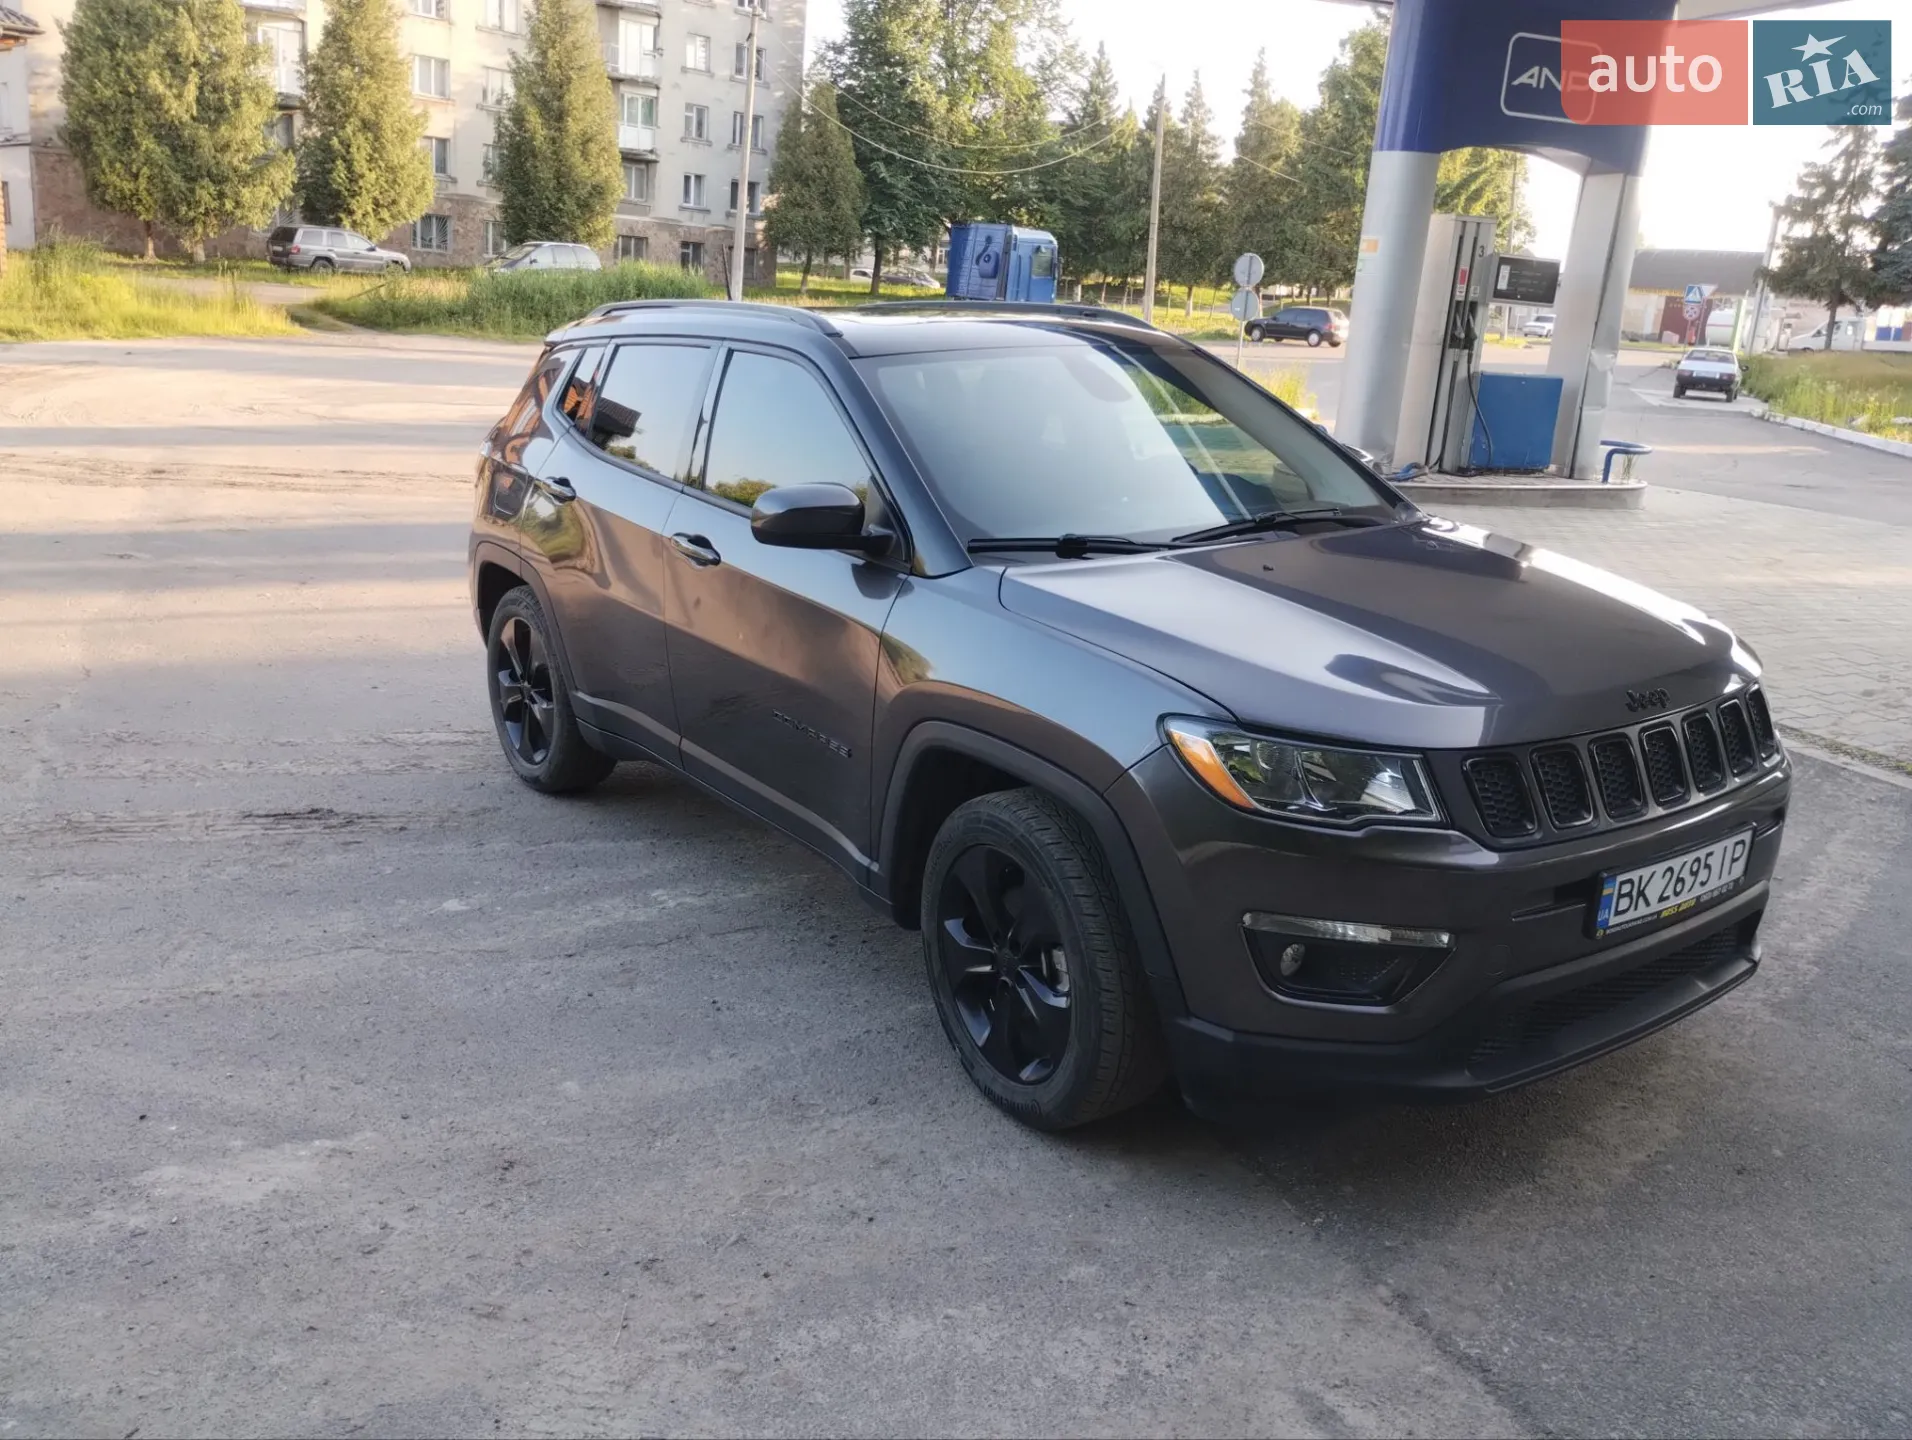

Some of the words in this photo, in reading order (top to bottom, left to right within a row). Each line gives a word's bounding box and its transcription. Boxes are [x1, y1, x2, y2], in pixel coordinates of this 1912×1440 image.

[1479, 245, 1485, 258] 3
[1625, 688, 1670, 712] Jeep
[1613, 870, 1657, 918] BK
[1657, 851, 1715, 904] 2695
[1718, 839, 1746, 880] IP
[1597, 910, 1609, 921] UA
